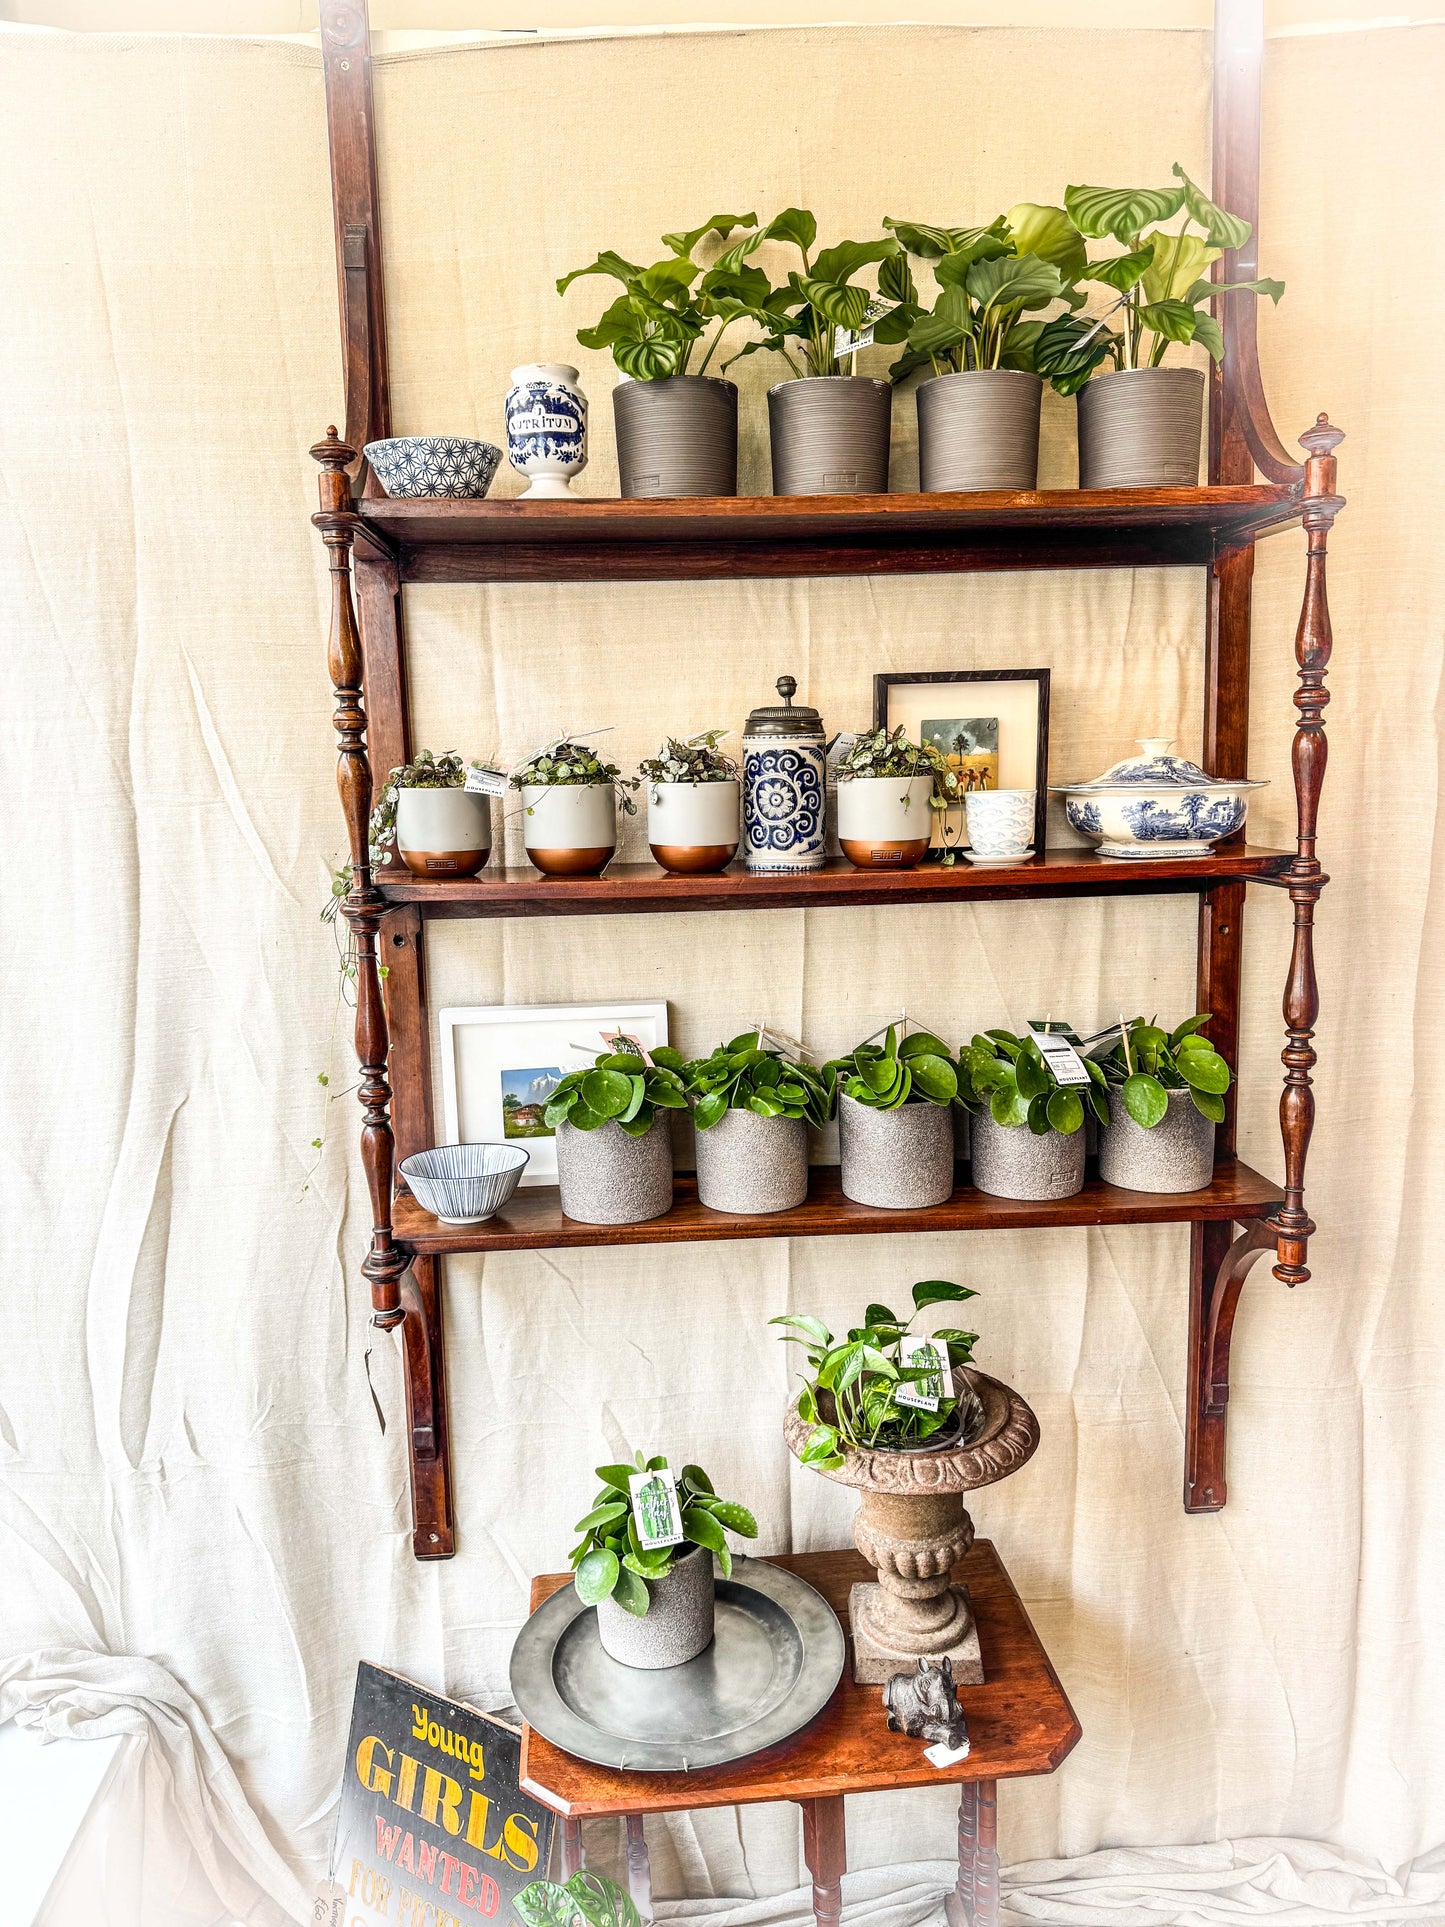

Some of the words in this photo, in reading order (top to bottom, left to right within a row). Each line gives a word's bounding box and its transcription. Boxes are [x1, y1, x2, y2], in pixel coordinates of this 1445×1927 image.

[898, 1395, 935, 1407] HOUSEPLANT
[645, 1536, 681, 1545] HOUSEPLANT
[411, 1703, 486, 1781] Young
[355, 1735, 540, 1873] GIRLS
[348, 1857, 393, 1916] FOR
[375, 1815, 500, 1918] WANTED
